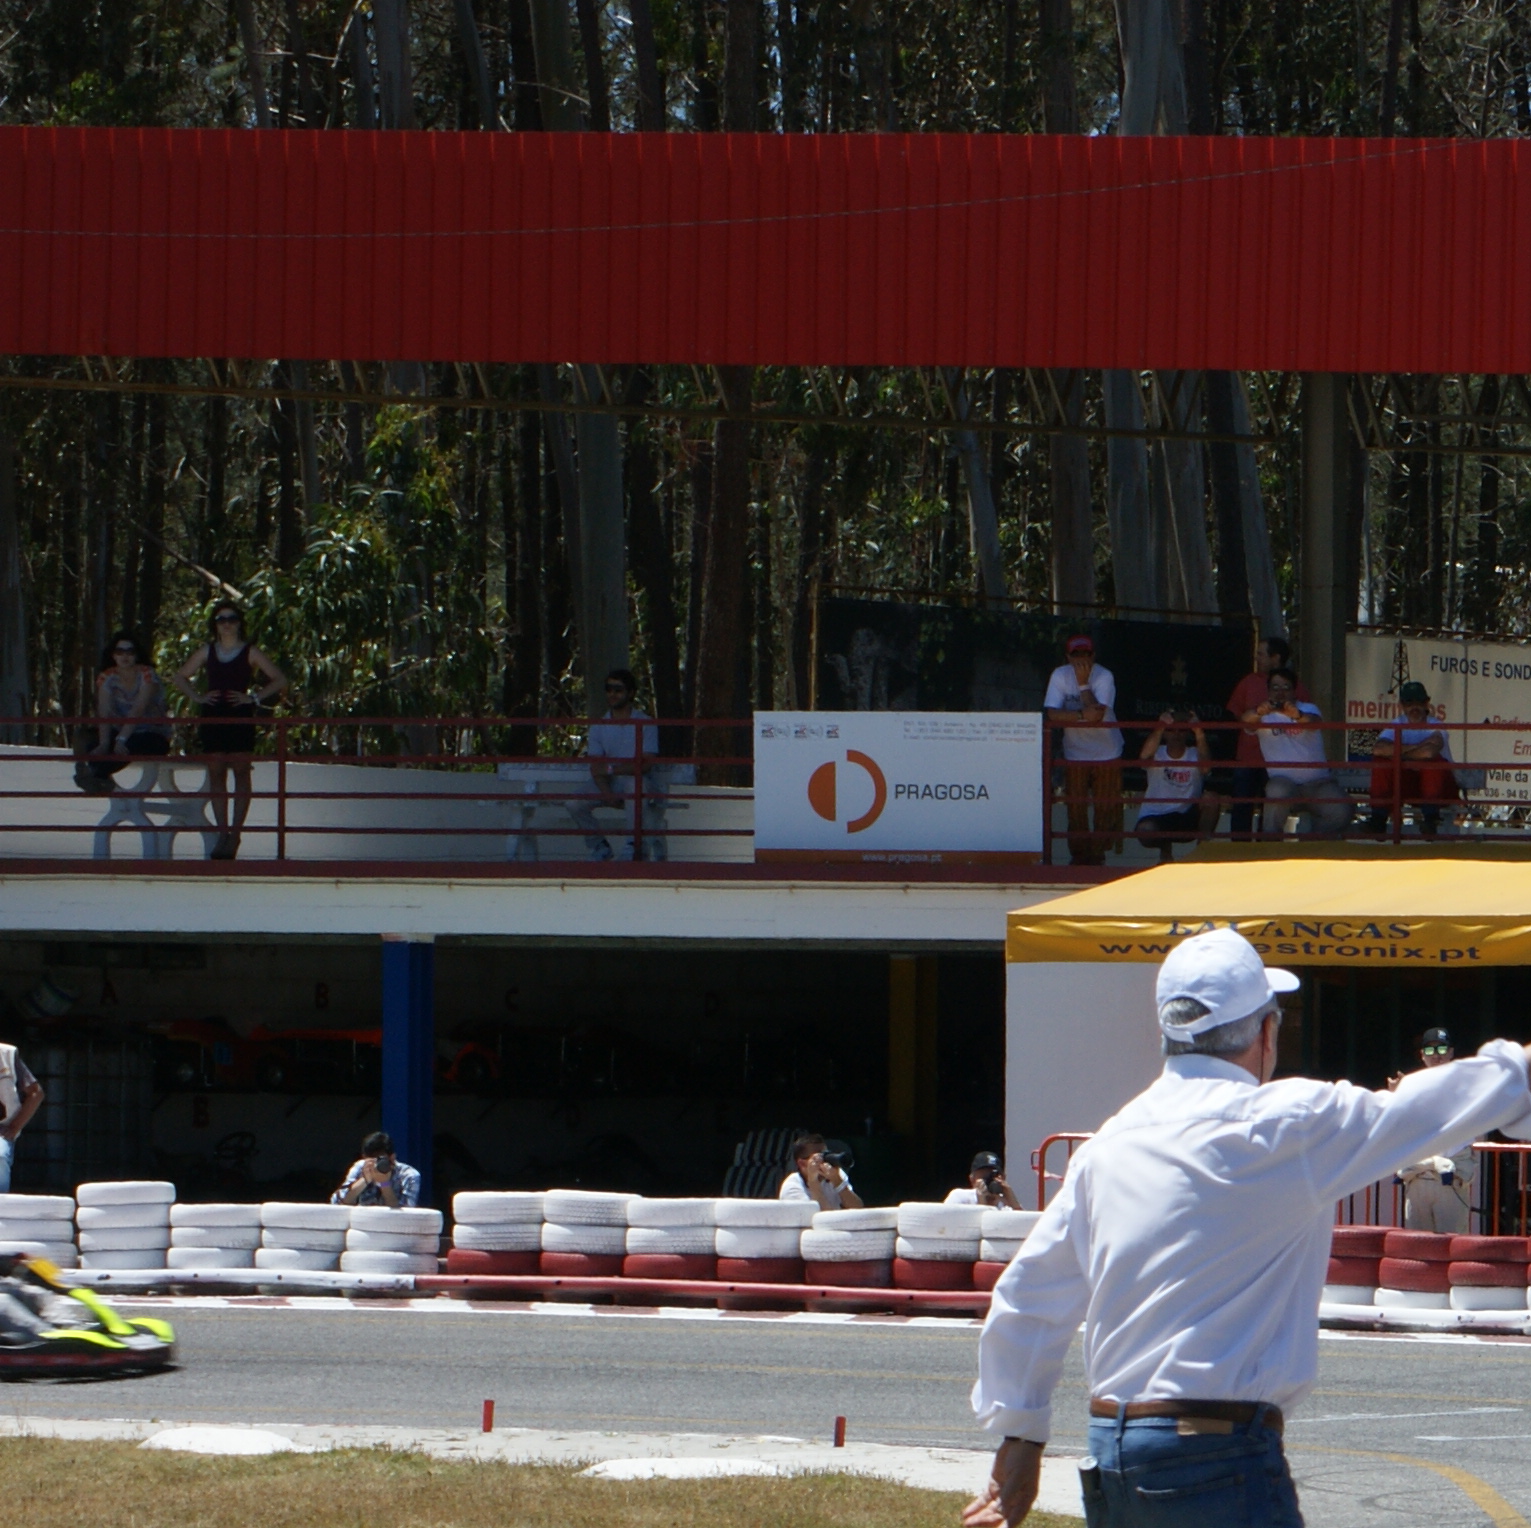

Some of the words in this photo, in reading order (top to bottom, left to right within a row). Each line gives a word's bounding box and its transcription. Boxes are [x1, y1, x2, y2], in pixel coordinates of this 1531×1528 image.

[1431, 655, 1478, 675] FUROS
[1482, 661, 1490, 677] E
[1489, 770, 1511, 782] Vale
[1515, 770, 1528, 783] da
[895, 784, 989, 800] PRAGOSA
[862, 852, 942, 864] www.pragosa.pt
[1099, 941, 1481, 963] wwestronix.pt
